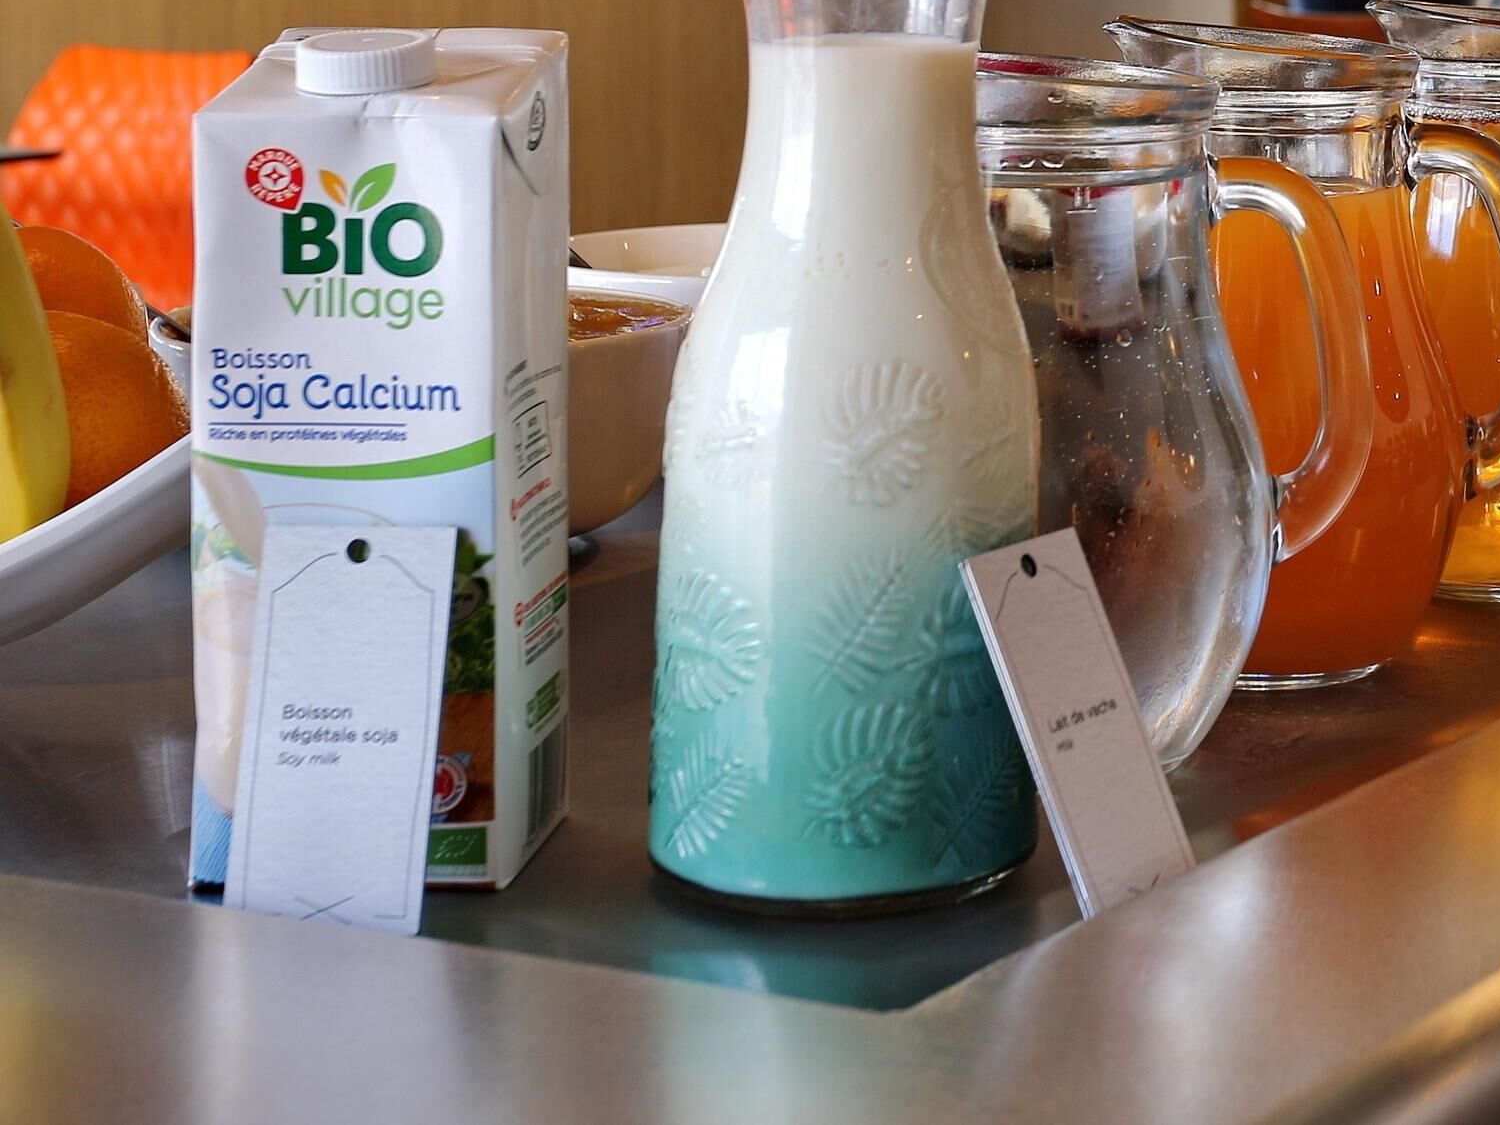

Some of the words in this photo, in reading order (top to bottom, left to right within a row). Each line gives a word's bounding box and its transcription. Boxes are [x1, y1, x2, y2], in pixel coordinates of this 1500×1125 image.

[281, 277, 444, 330] village
[210, 348, 312, 369] Boisson
[208, 374, 290, 420] Soja
[302, 373, 462, 412] Calcium
[208, 428, 248, 441] Riche
[250, 429, 268, 441] en
[270, 427, 338, 443] protéines
[341, 428, 409, 444] végétales
[281, 703, 353, 720] Boisson
[279, 726, 358, 746] végétale
[361, 727, 399, 746] soja
[275, 751, 305, 768] Soy
